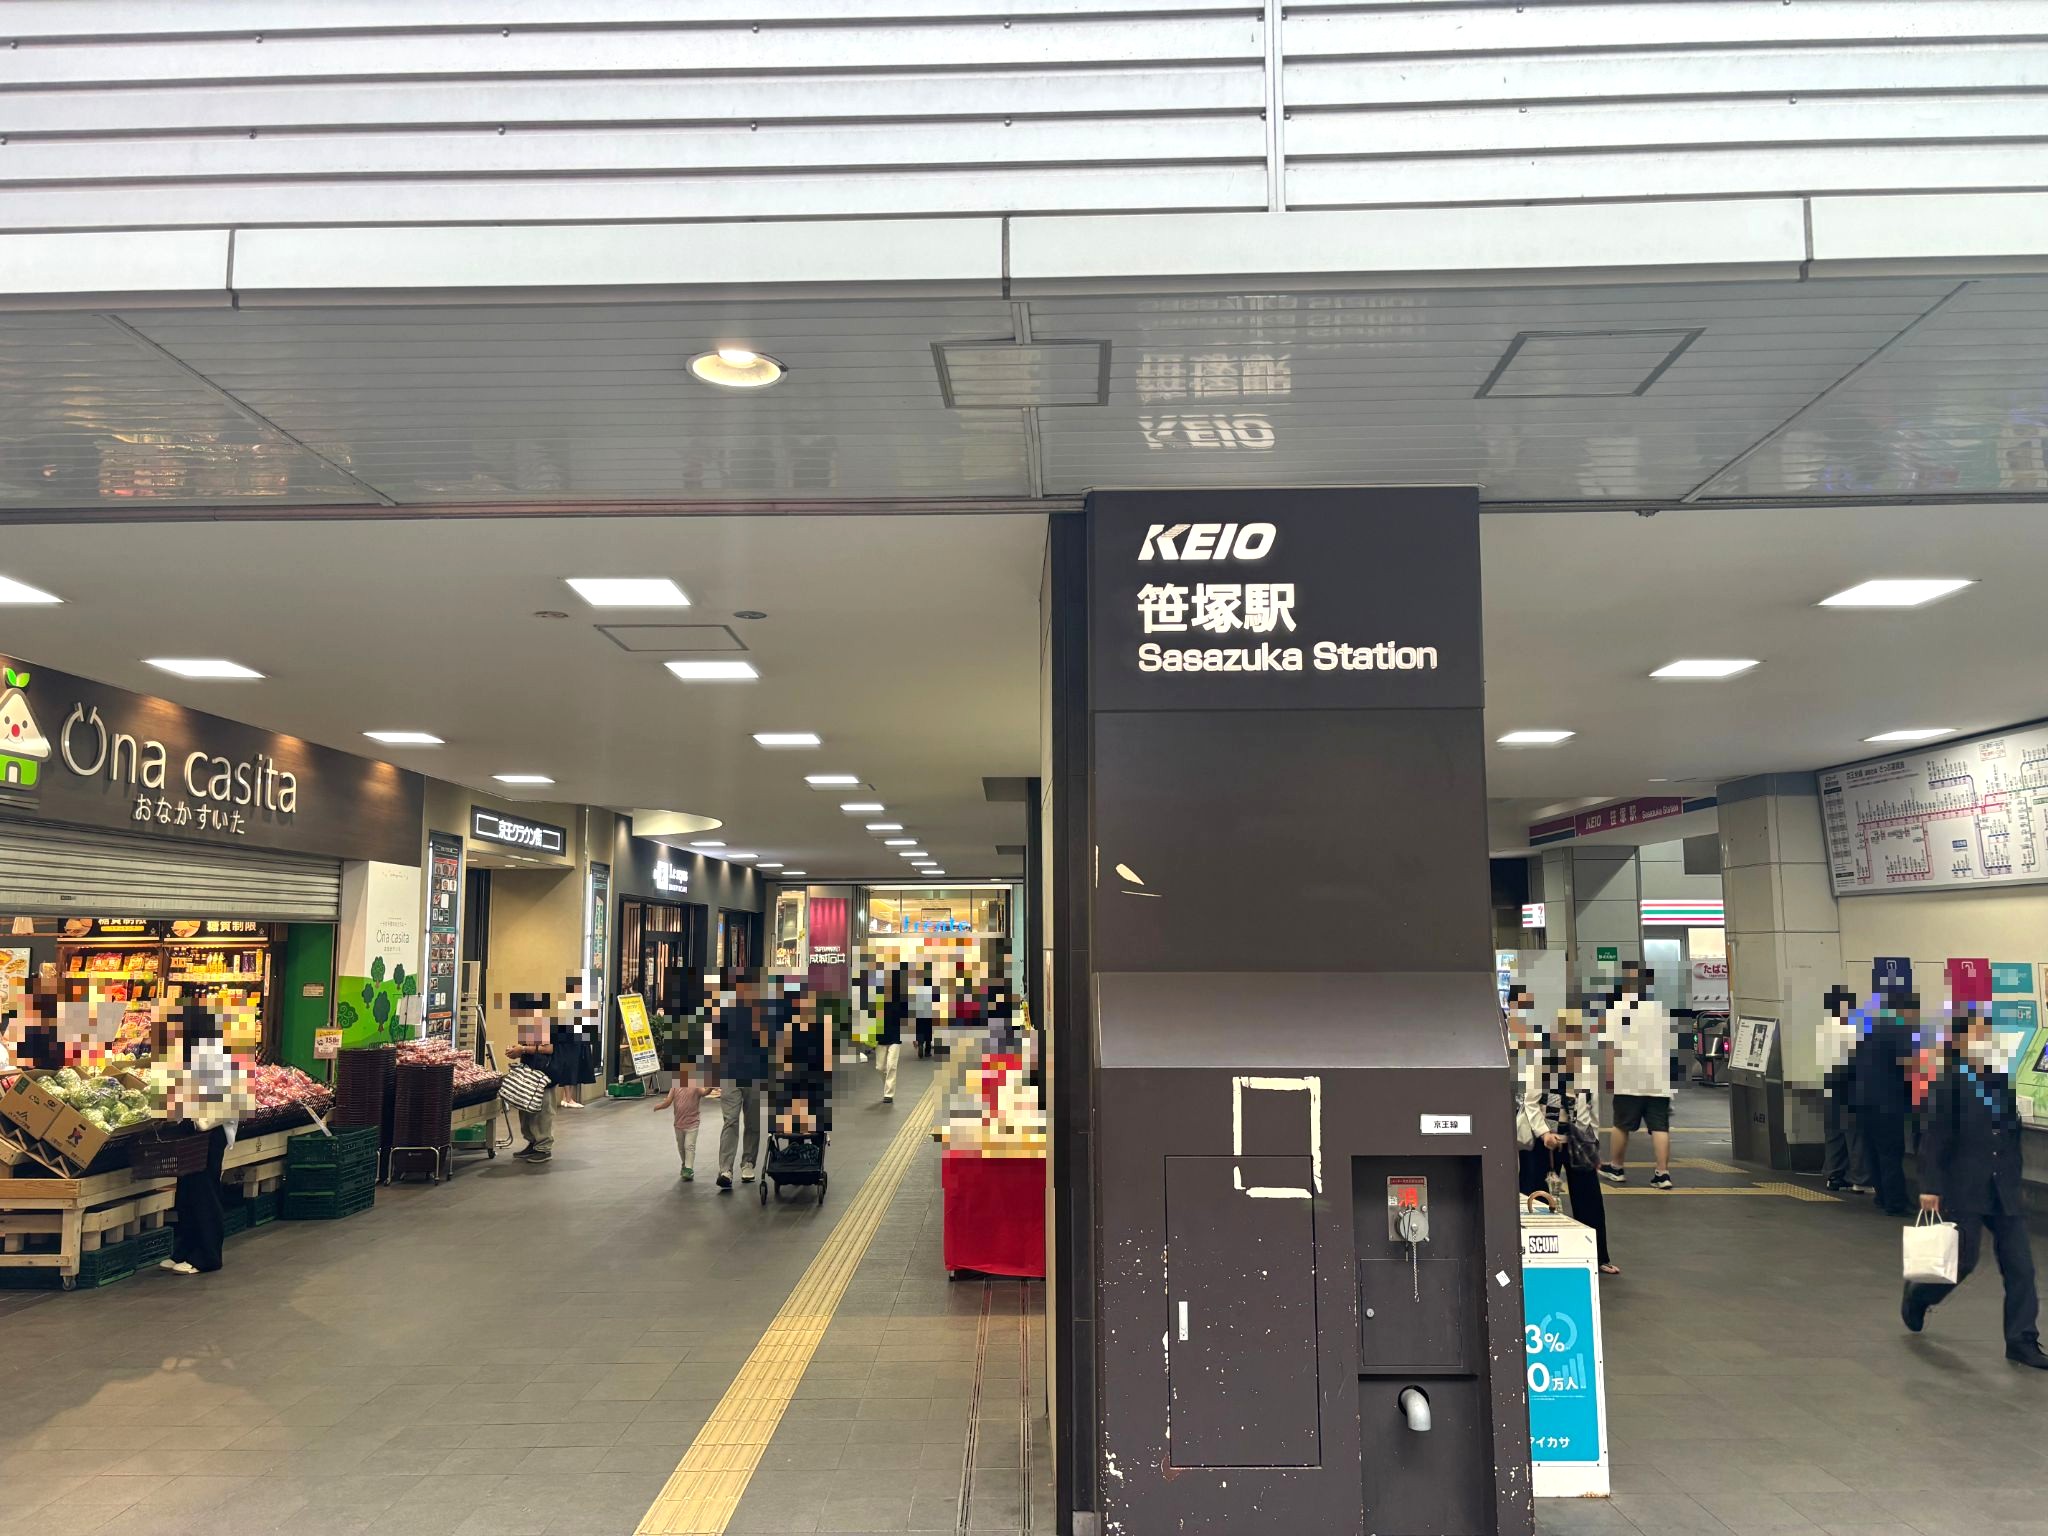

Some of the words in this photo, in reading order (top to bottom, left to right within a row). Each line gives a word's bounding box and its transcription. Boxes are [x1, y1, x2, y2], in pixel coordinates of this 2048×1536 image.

[1138, 522, 1277, 561] KEIO
[1137, 583, 1297, 634] 笹塚駅
[1138, 642, 1302, 672] Sasazuka
[1313, 640, 1438, 671] Station
[184, 753, 297, 814] casita
[132, 793, 246, 835] おなかすいた
[1433, 1119, 1459, 1130] 京王線
[1529, 1236, 1558, 1253] SCUM
[1528, 1363, 1578, 1393] 0万人
